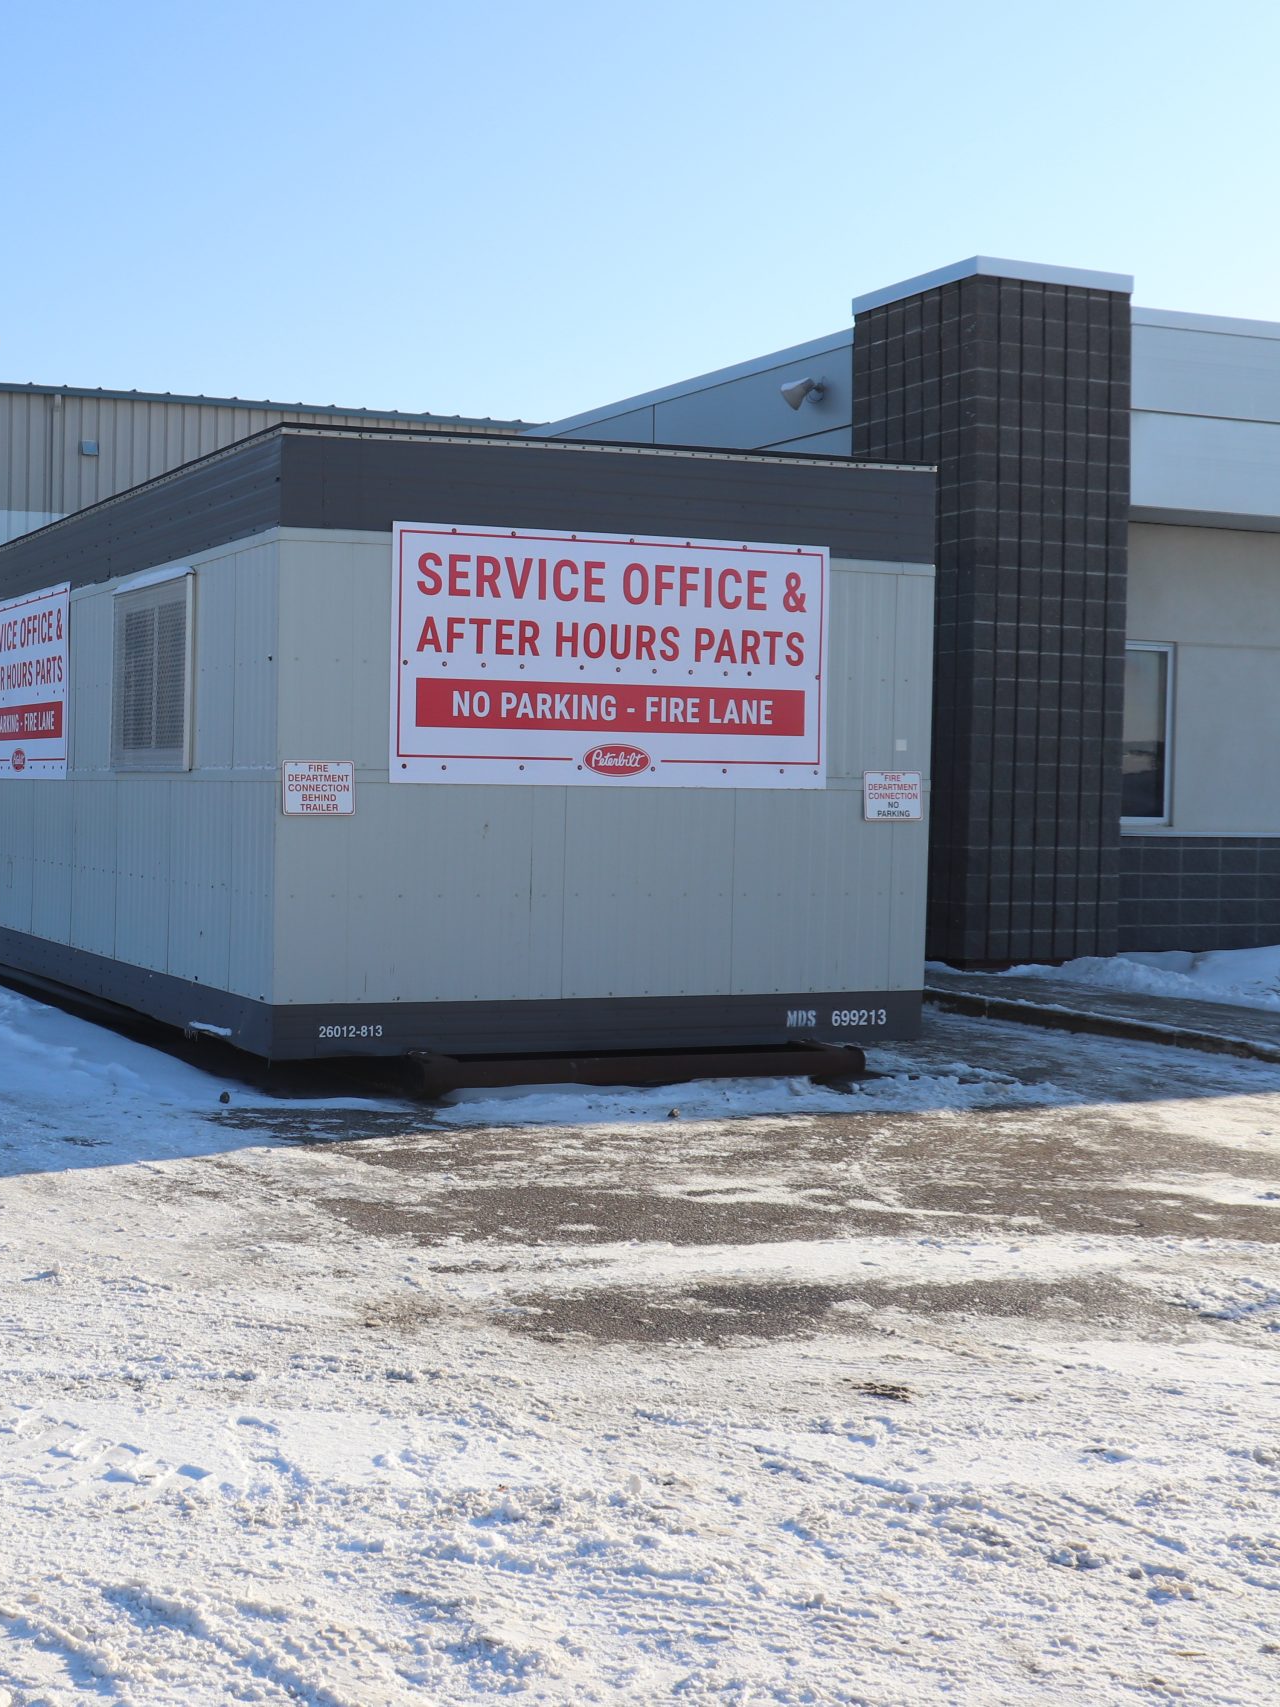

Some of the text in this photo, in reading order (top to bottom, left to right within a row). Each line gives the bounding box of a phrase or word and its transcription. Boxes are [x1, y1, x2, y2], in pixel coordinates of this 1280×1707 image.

[416, 551, 807, 614] SERVICE OFFICE &
[20, 610, 53, 648] OFFICE
[56, 607, 63, 641] &
[416, 616, 805, 668] AFTER HOURS PARTS
[6, 660, 33, 690] HOURS
[35, 655, 63, 686] PARTS
[452, 690, 491, 718] NO
[500, 692, 617, 722] PARKING
[645, 696, 700, 723] FIRE
[708, 699, 773, 725] LANE
[24, 712, 37, 732] FIRE
[38, 710, 55, 731] LANE
[591, 749, 646, 768] Peterbilt
[308, 764, 329, 772] FIRE
[288, 774, 350, 782] DEPARTMENT
[884, 774, 902, 782] FIRE
[288, 783, 350, 792] CONNECTION
[868, 783, 918, 791] DEPARTMENT
[301, 793, 337, 802] BEHIND
[868, 792, 918, 800] CONNECTION
[300, 803, 339, 812] TRAILER
[887, 801, 900, 809] NO
[877, 810, 911, 818] PARKING
[786, 1009, 887, 1027] MDS 699213
[318, 1025, 383, 1038] 26012-813
